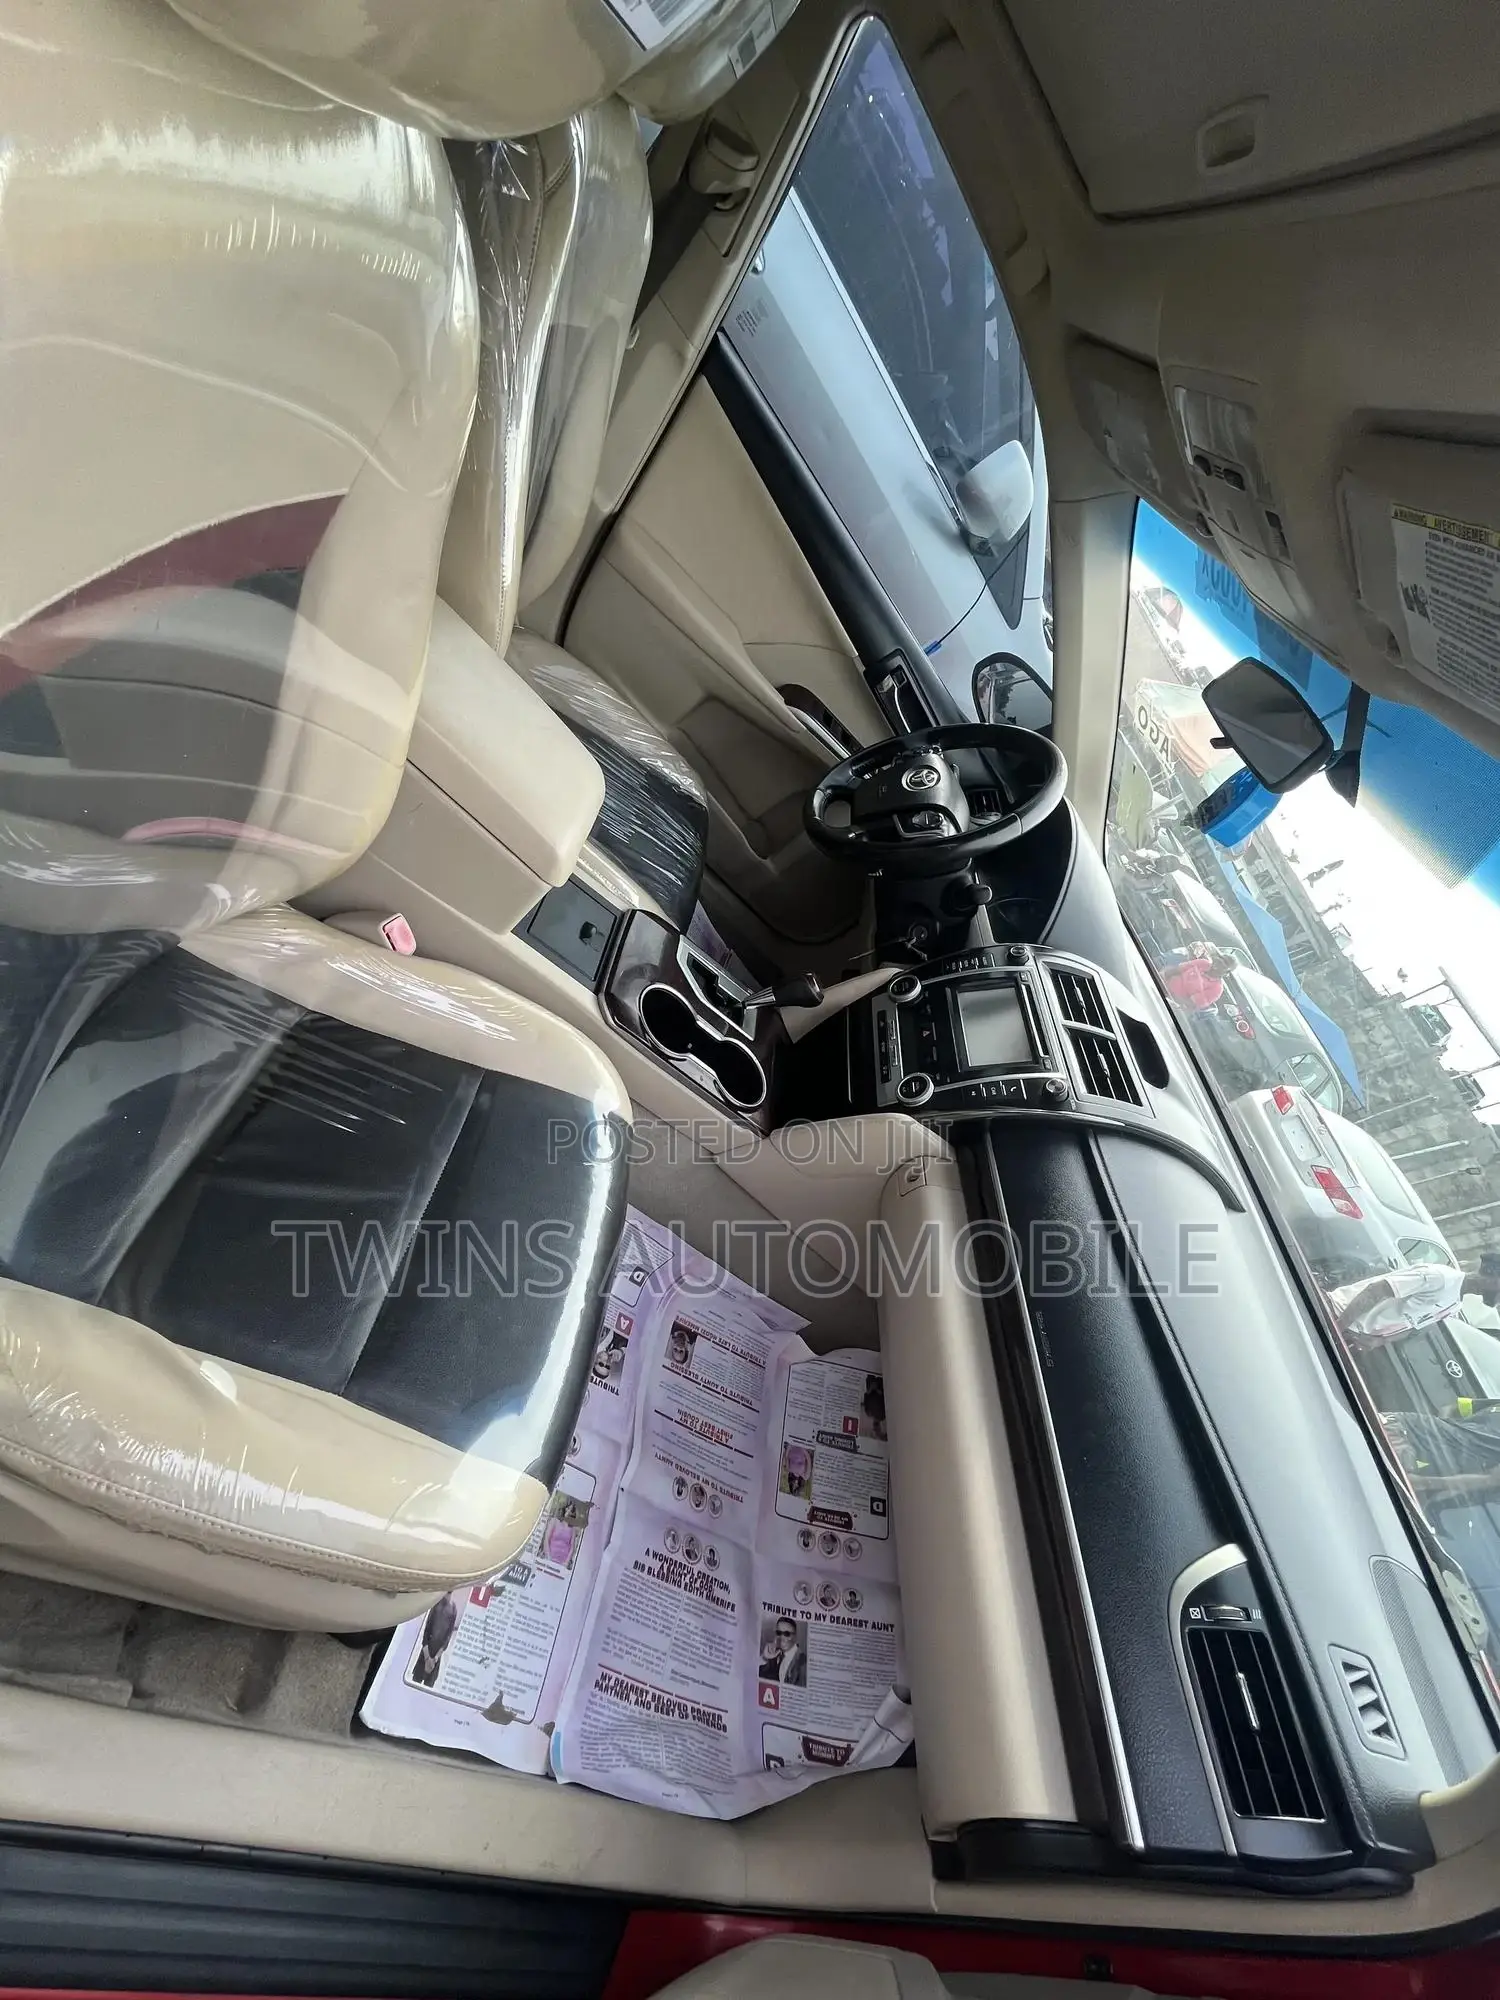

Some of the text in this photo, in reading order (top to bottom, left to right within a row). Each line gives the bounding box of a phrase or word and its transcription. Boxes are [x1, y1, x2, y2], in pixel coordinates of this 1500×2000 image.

[700, 1375, 719, 1389] AUNTY
[729, 1389, 753, 1406] TRIBUTE
[677, 1409, 700, 1423] COUSIN
[655, 1452, 744, 1503] TRIBUTE TO MY BELOVED AUNTY
[652, 1550, 695, 1576] WONDERFUL
[647, 1567, 682, 1590] BLESSING
[684, 1582, 705, 1599] EDITH
[762, 1601, 895, 1633] TRIBUTE TO MY DEAREST AUNT
[600, 1671, 723, 1722] MY DEAREST BELOVED PRAYER
[763, 1687, 776, 1706] A
[634, 1698, 651, 1711] AND
[654, 1704, 676, 1718] BEST
[678, 1710, 690, 1720] OF
[692, 1713, 728, 1733] FRIENDS
